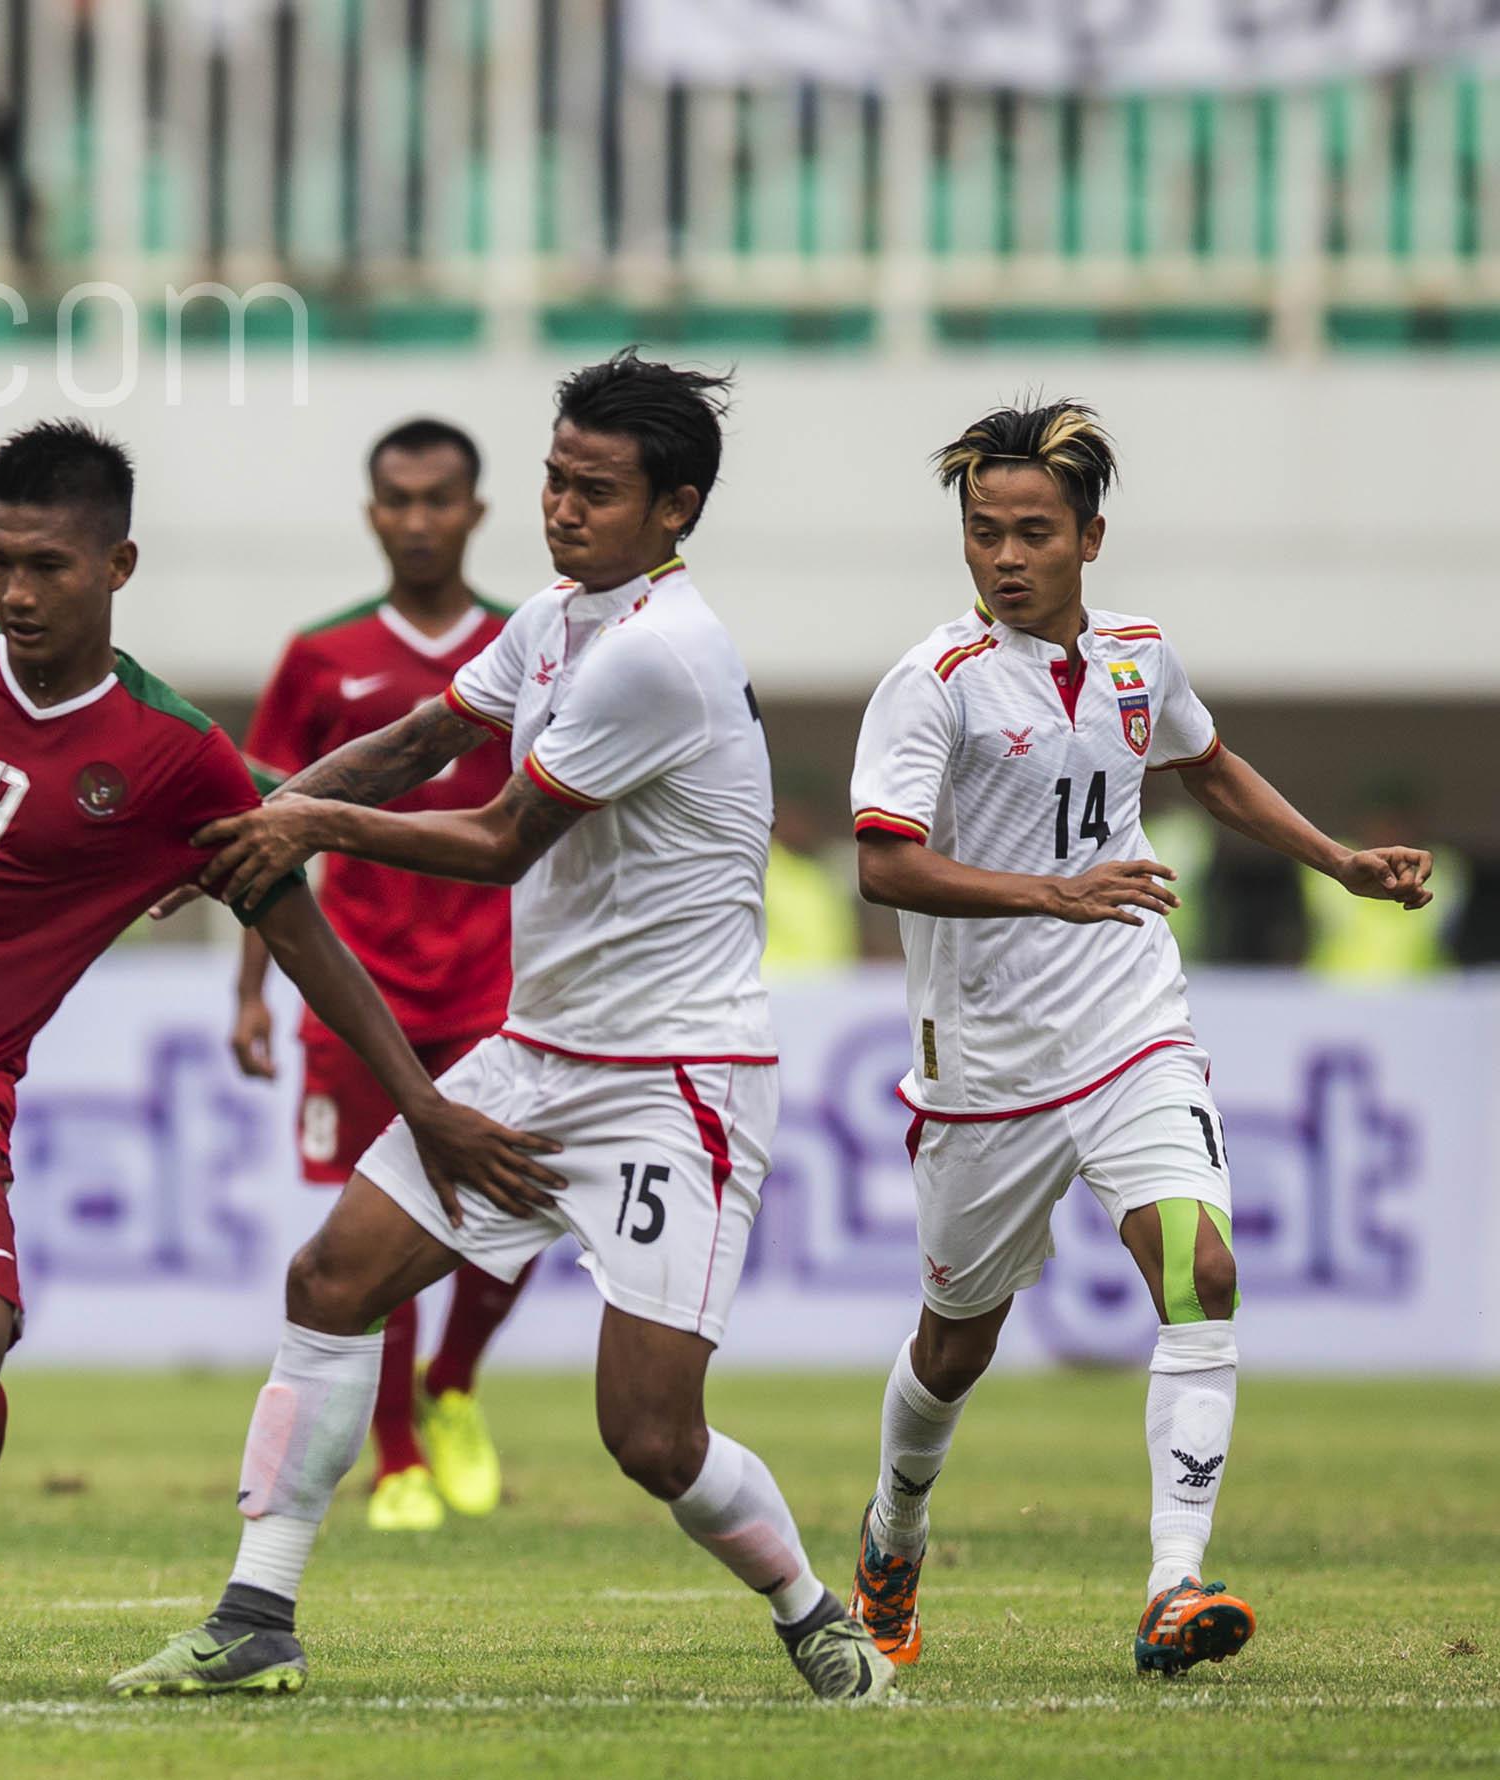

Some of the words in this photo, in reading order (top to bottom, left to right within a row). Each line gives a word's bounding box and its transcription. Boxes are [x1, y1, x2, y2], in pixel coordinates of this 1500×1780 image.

[1055, 771, 1111, 860] 14
[1189, 1105, 1229, 1171] 1
[616, 1162, 670, 1245] 15
